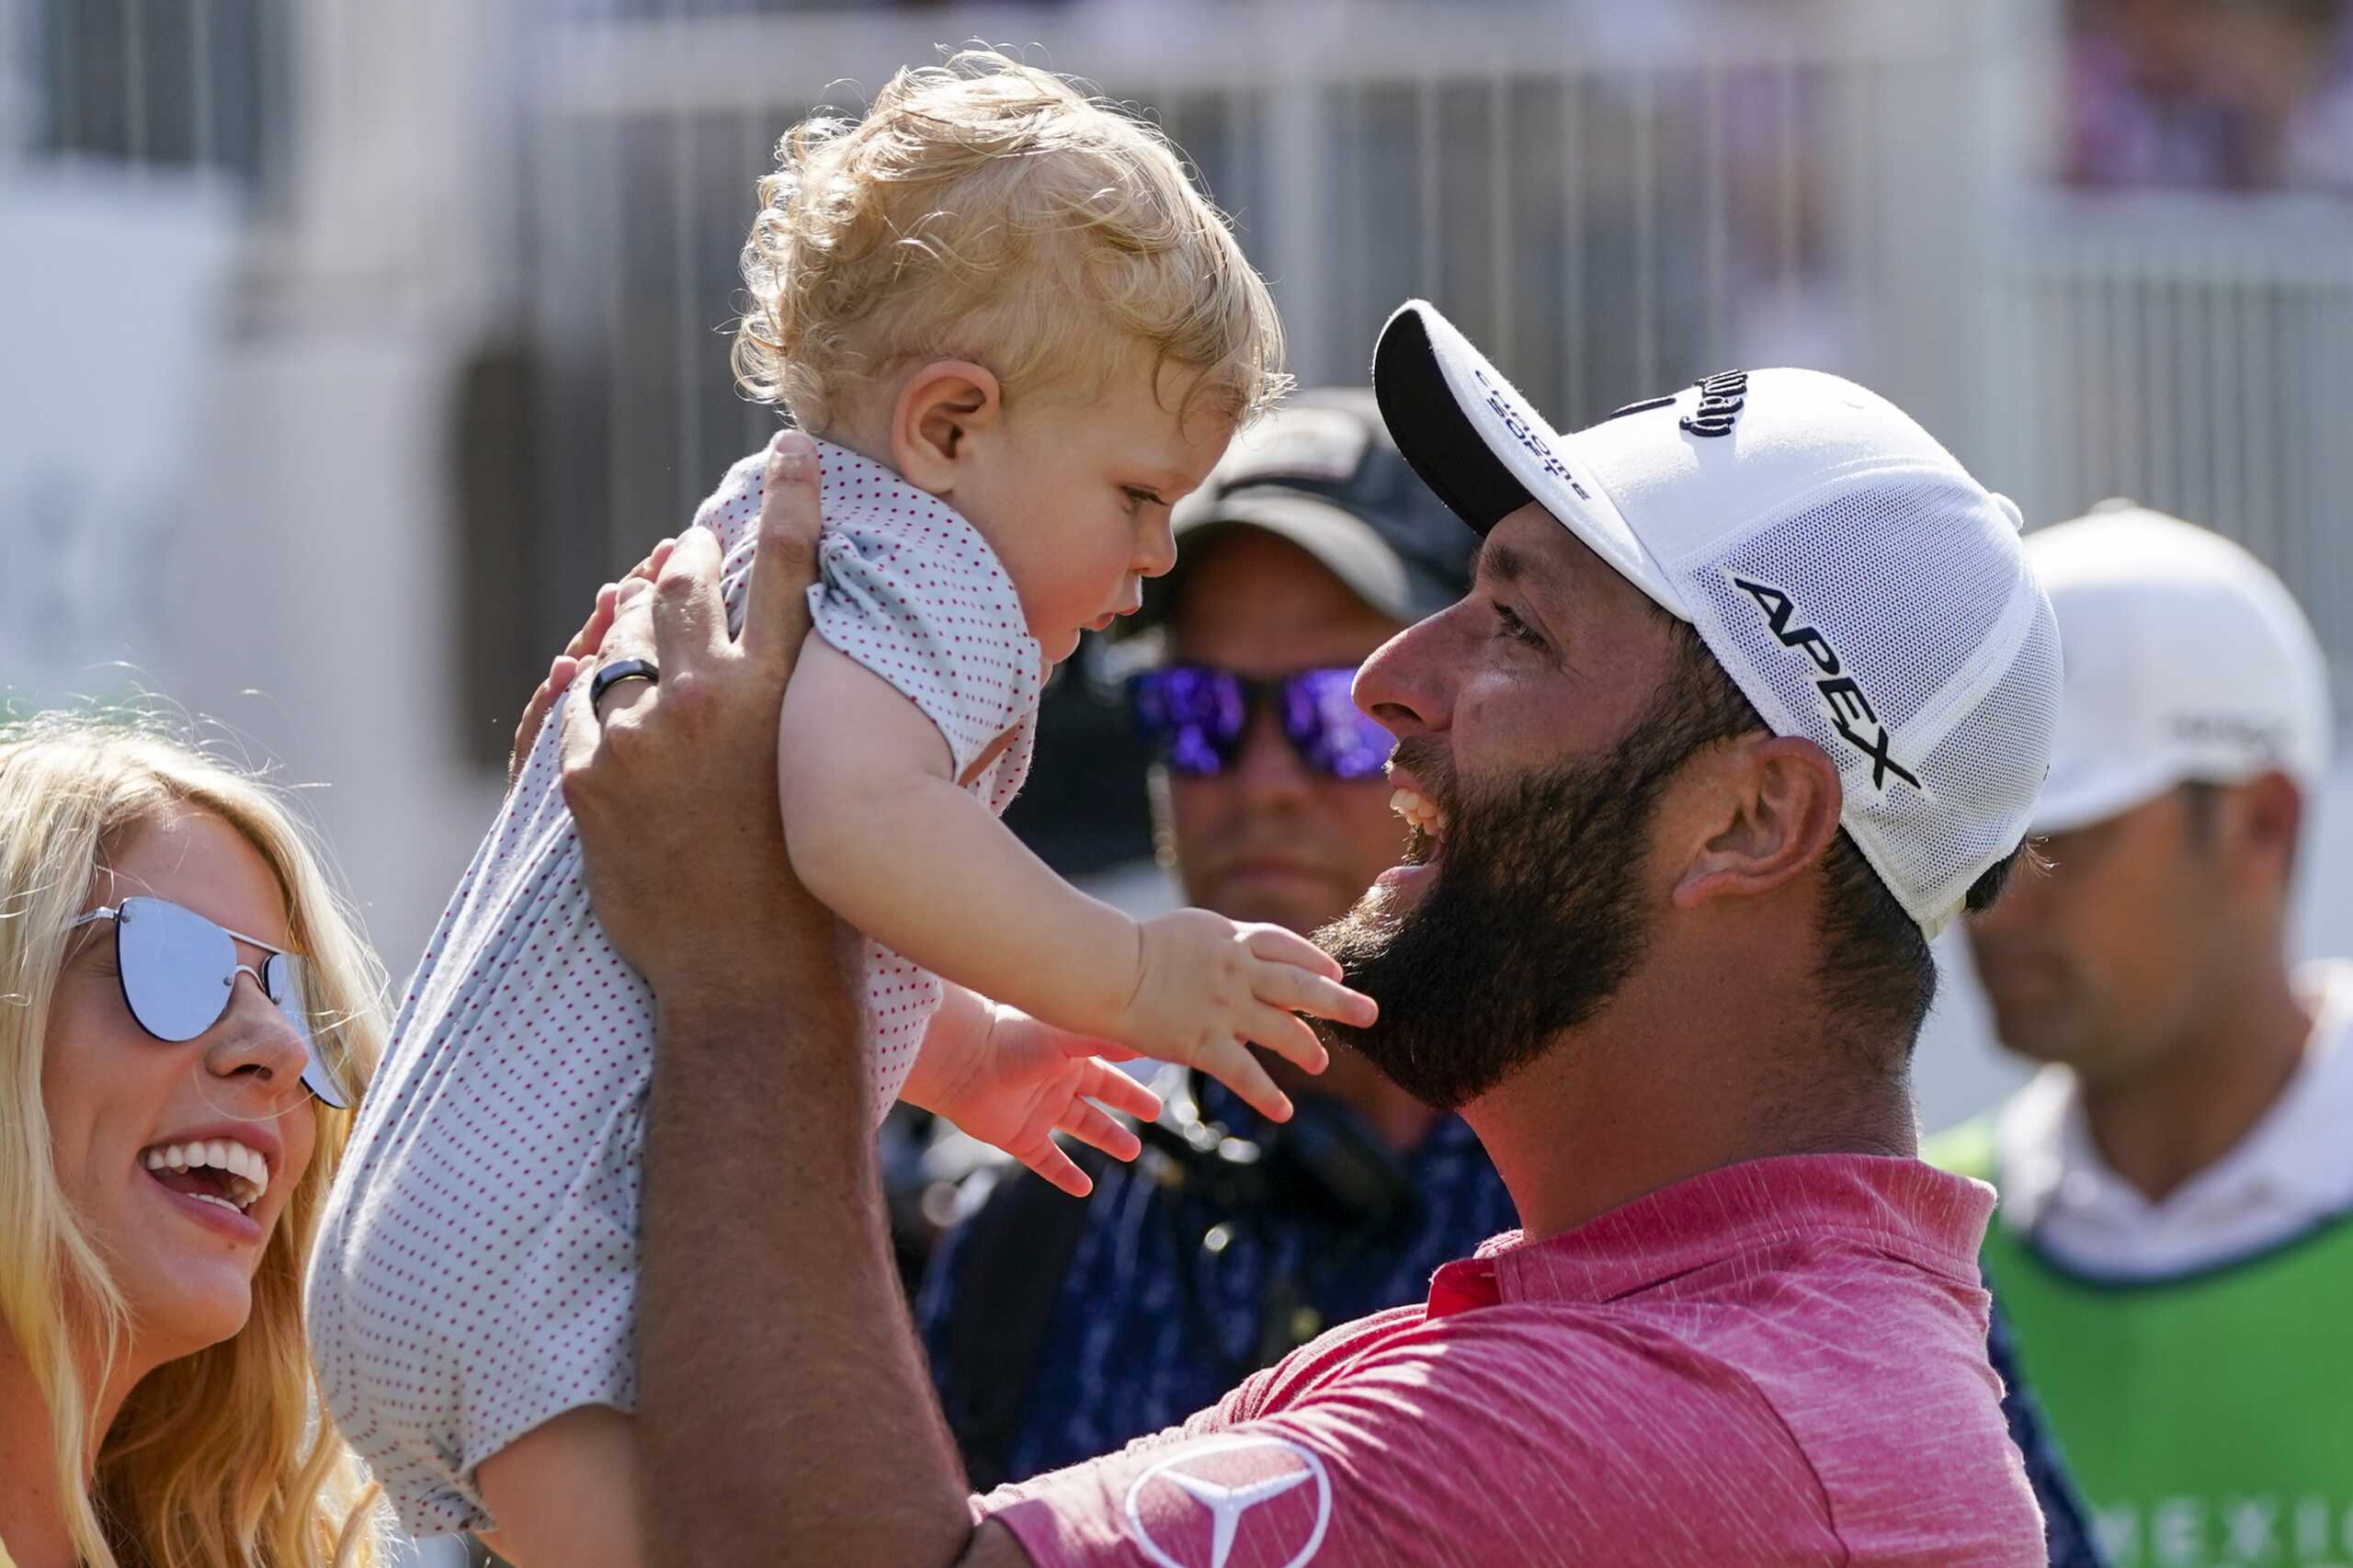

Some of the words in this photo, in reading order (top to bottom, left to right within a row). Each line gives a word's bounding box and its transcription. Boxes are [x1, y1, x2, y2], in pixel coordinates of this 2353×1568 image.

[1485, 397, 1559, 476] SOFT
[1733, 577, 1922, 790] APEX
[2088, 1496, 2353, 1566] MEXI
